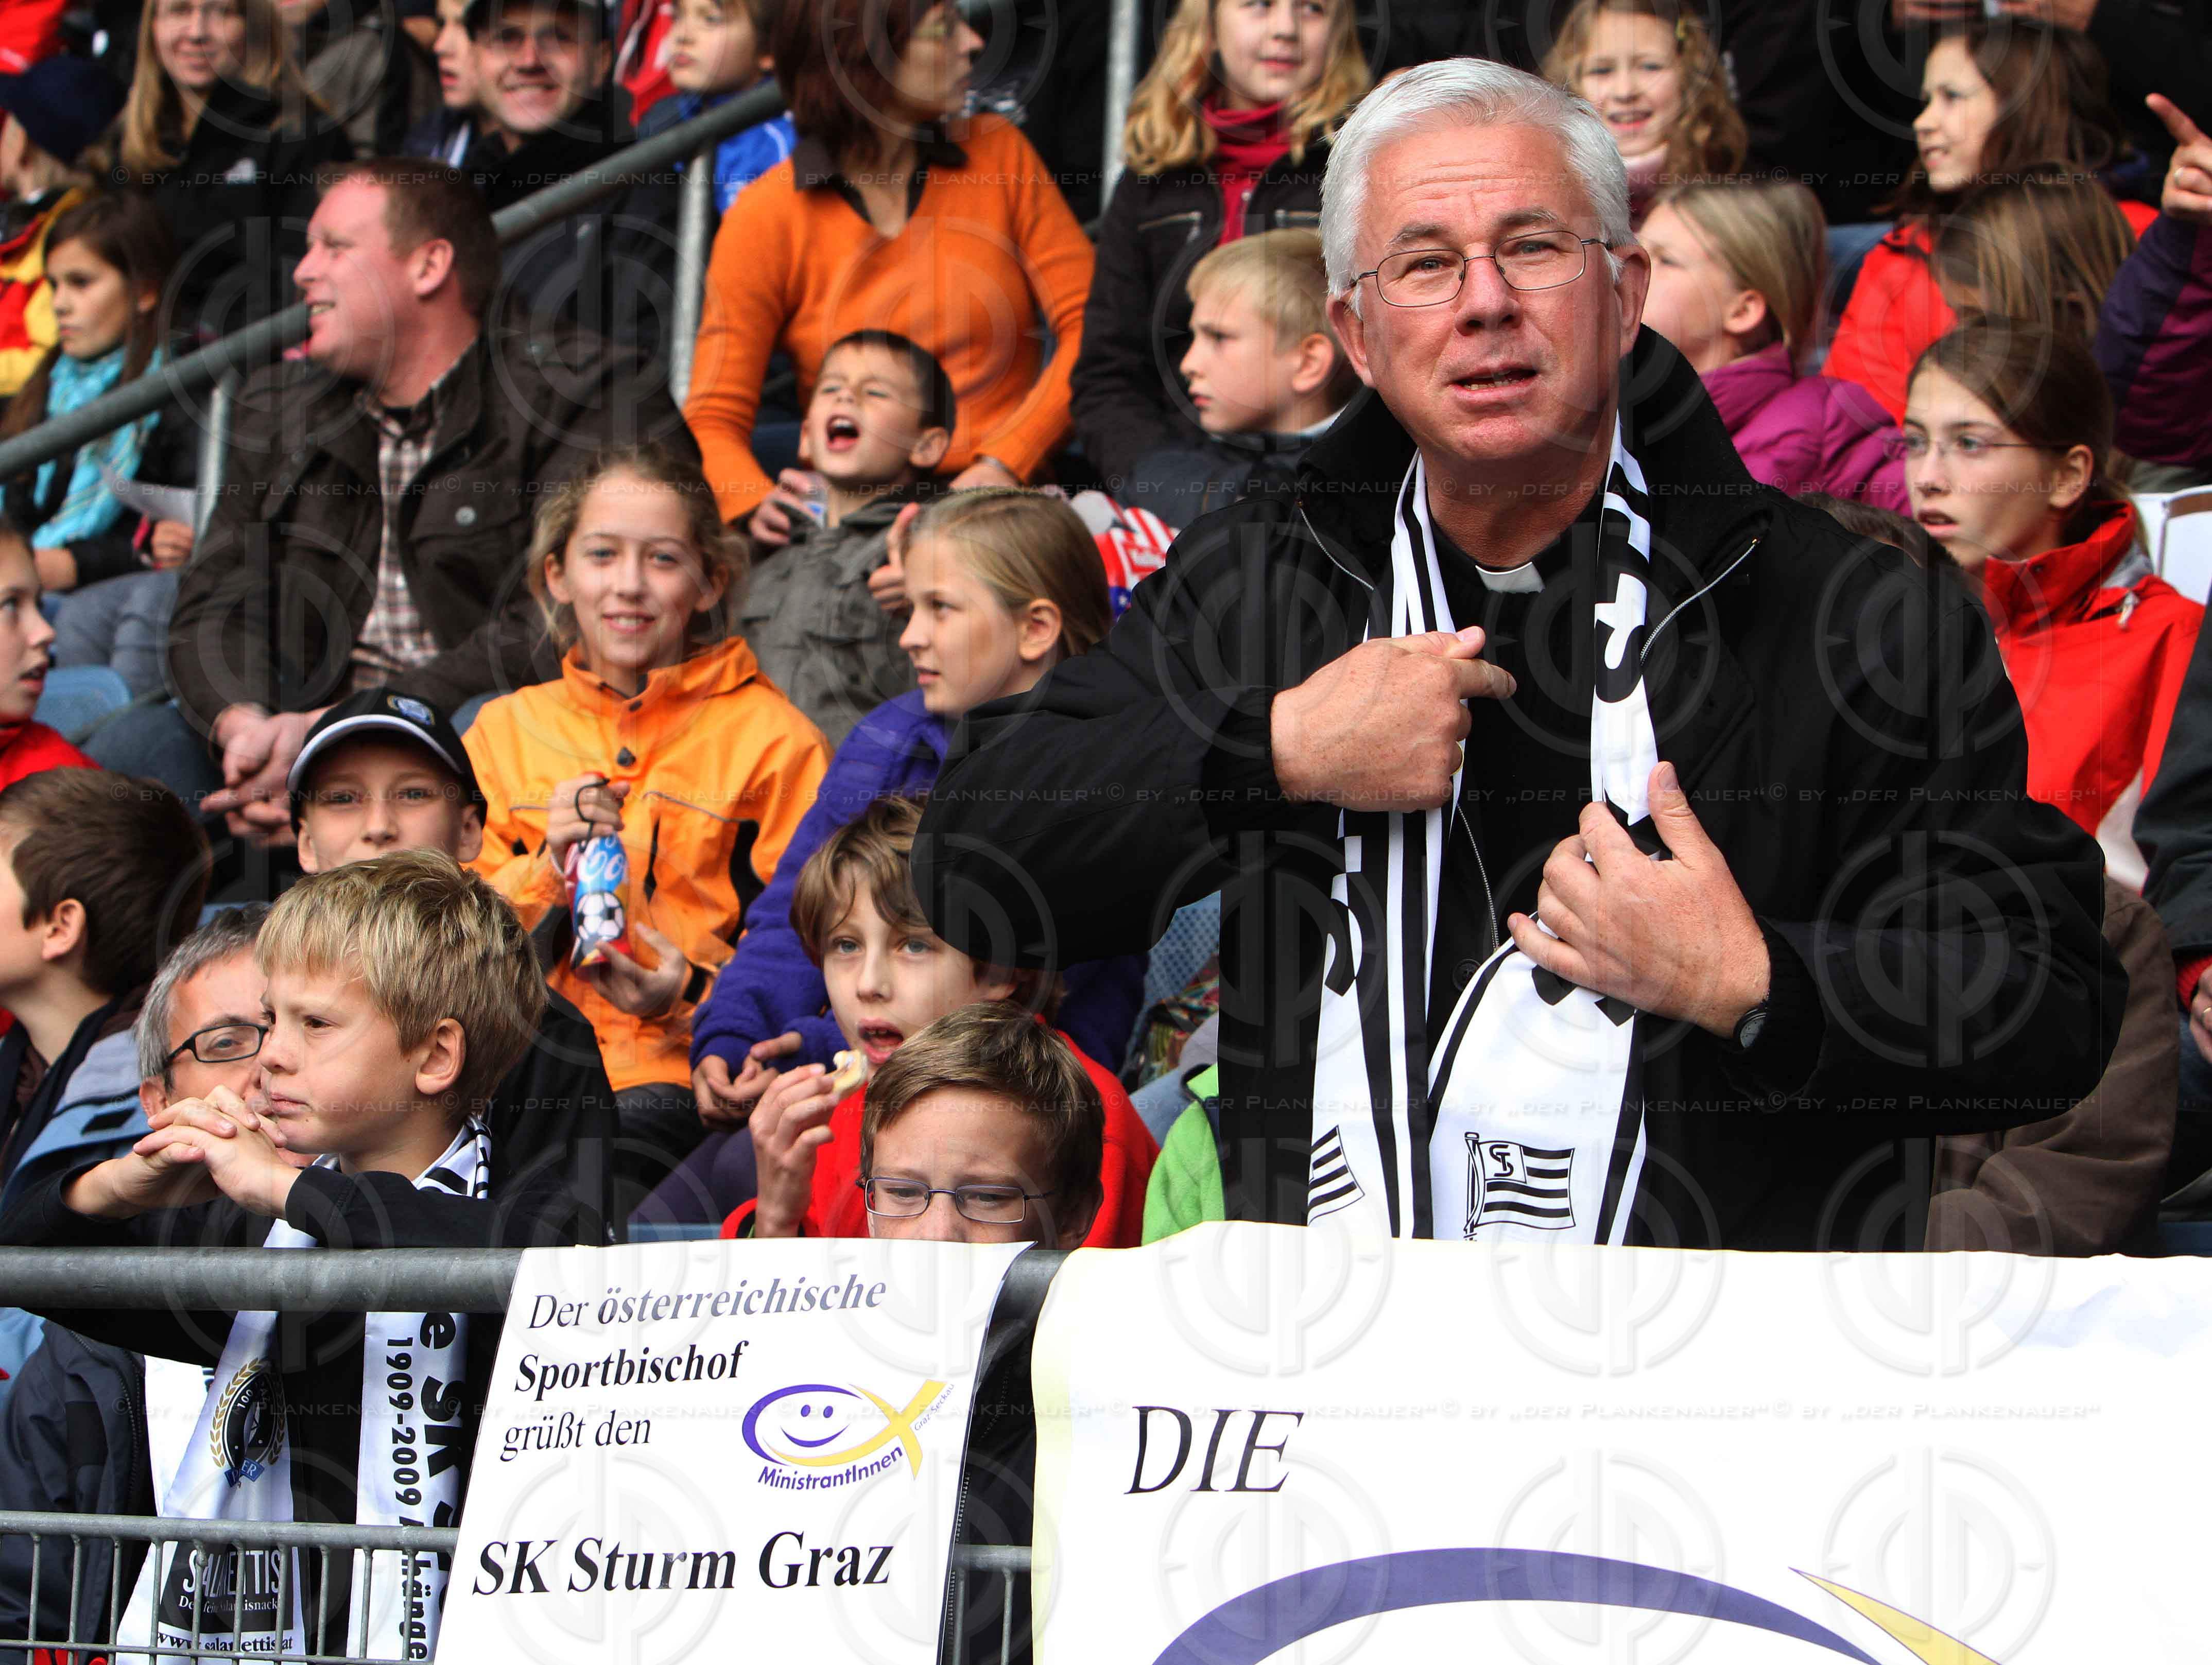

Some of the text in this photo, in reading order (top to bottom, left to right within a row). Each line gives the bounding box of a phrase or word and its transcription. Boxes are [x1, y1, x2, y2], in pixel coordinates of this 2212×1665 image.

[526, 1275, 886, 1329] Der österreichische
[513, 1341, 748, 1400] Sportbischof
[386, 1337, 422, 1505] 1909-2009
[914, 1383, 955, 1431] Graz-Seckau
[499, 1410, 651, 1462] grüßt den
[1124, 1406, 1304, 1496] DIE
[758, 1446, 904, 1490] MinistrantInnen
[472, 1541, 558, 1596] SK
[567, 1537, 735, 1592] Sturm
[758, 1532, 894, 1588] Graz
